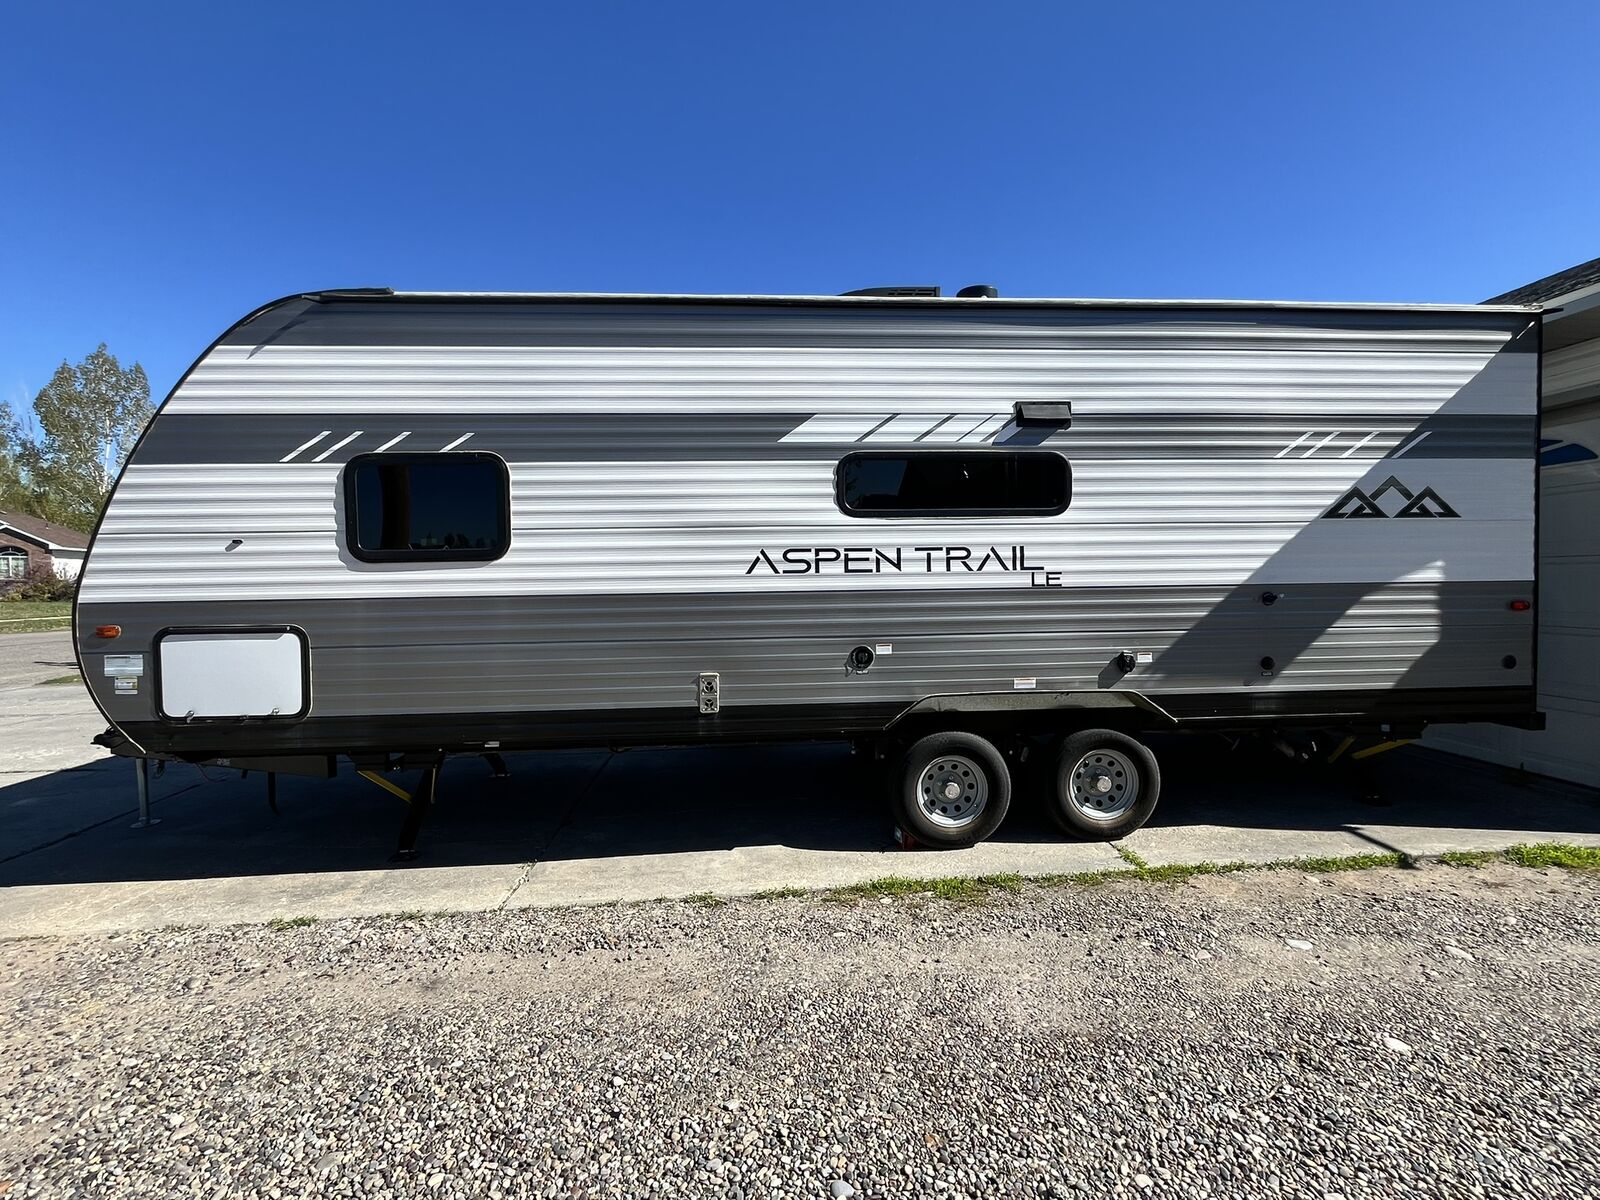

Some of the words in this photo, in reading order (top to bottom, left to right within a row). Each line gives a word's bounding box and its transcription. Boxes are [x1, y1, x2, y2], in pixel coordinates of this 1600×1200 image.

[745, 547, 902, 574] ASPEN
[914, 545, 1045, 572] TRAIL
[1031, 571, 1063, 587] LE
